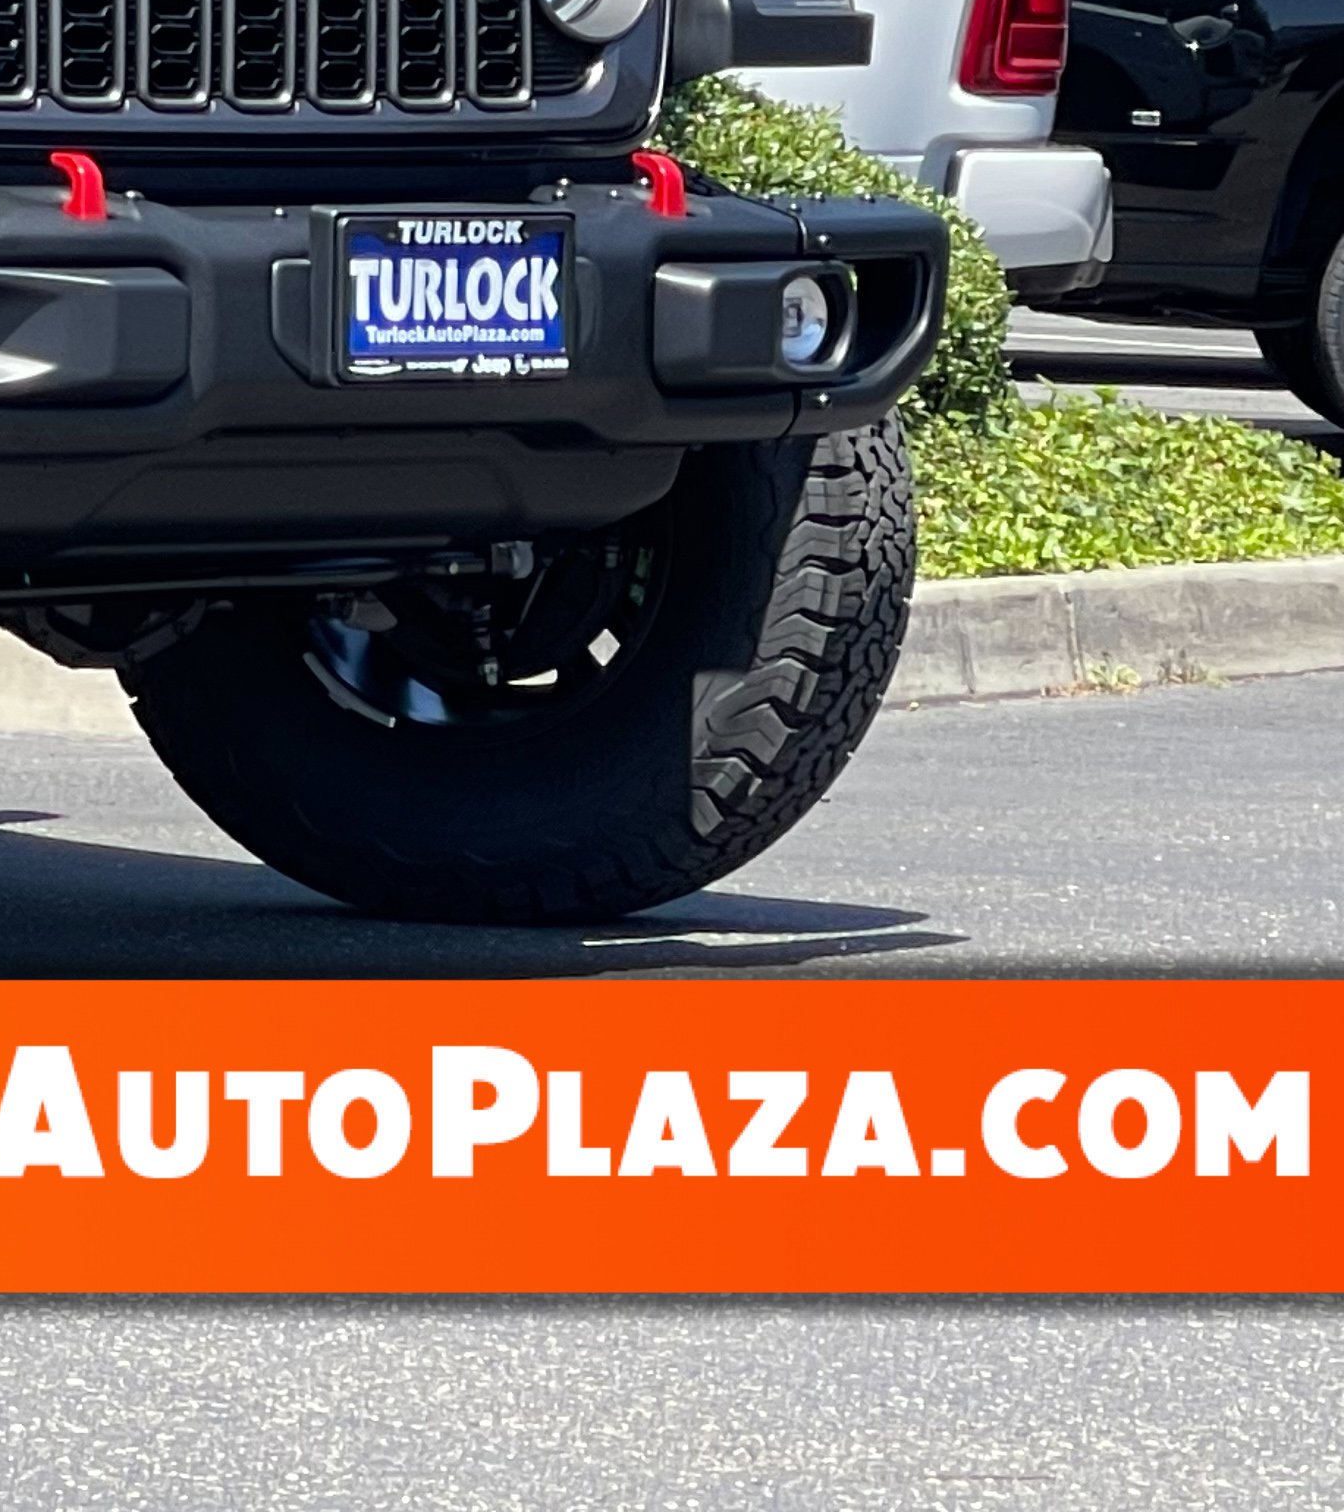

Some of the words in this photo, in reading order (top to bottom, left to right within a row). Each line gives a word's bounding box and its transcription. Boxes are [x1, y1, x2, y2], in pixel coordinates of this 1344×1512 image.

[398, 220, 524, 244] TURLOCK
[349, 257, 560, 321] TURLOCK
[365, 324, 545, 344] TurlockAutoPlaza.com
